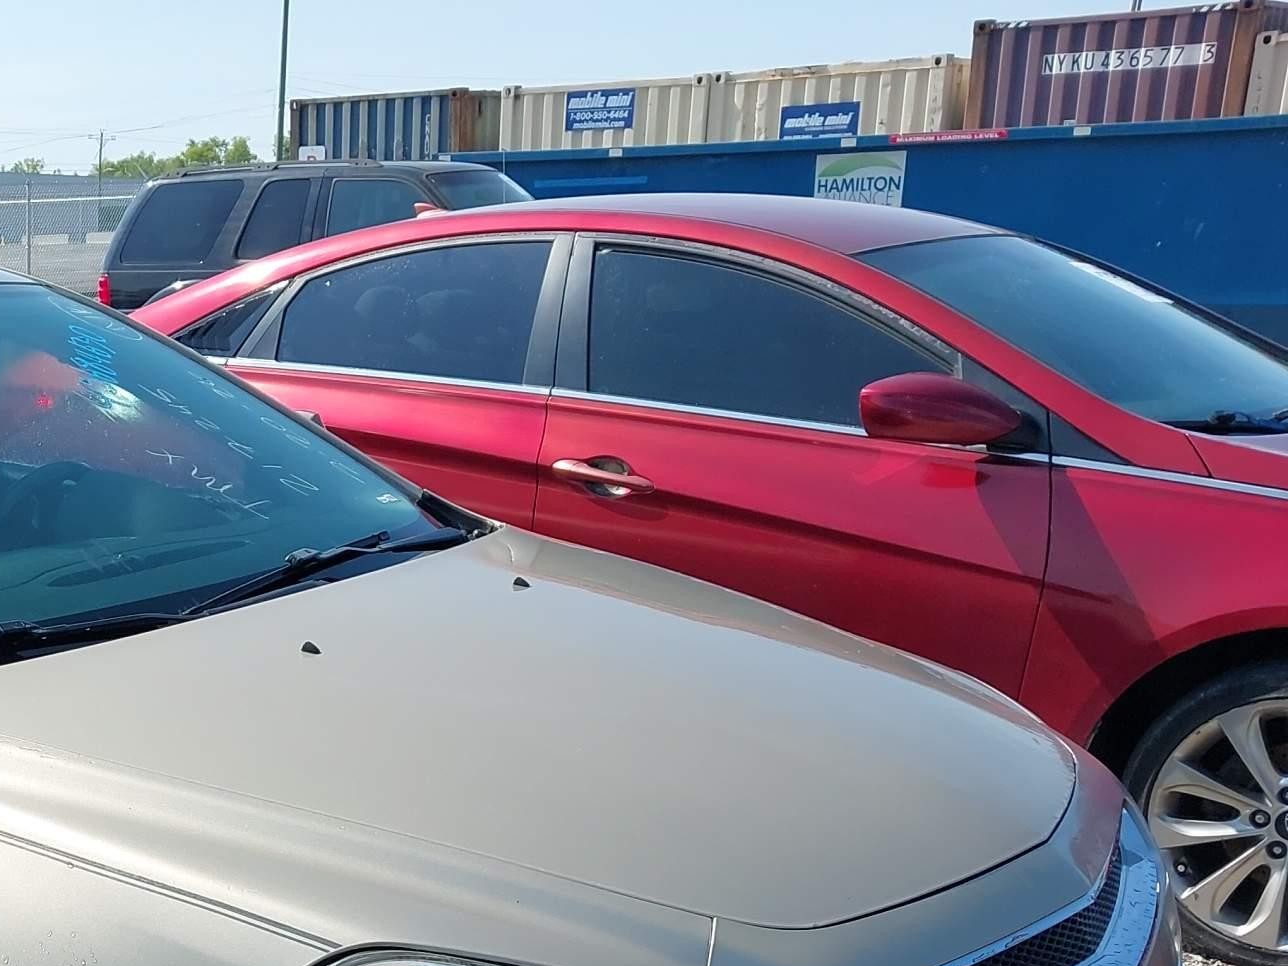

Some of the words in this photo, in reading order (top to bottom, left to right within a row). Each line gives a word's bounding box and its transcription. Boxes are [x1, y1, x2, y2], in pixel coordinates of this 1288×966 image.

[1043, 52, 1095, 73] NYKU
[1101, 46, 1185, 70] 436577
[1202, 43, 1216, 62] 3
[568, 92, 606, 109] mobile
[606, 92, 633, 107] mini
[784, 113, 824, 128] mobile
[824, 112, 854, 125] mini
[817, 176, 901, 193] HAMILTON
